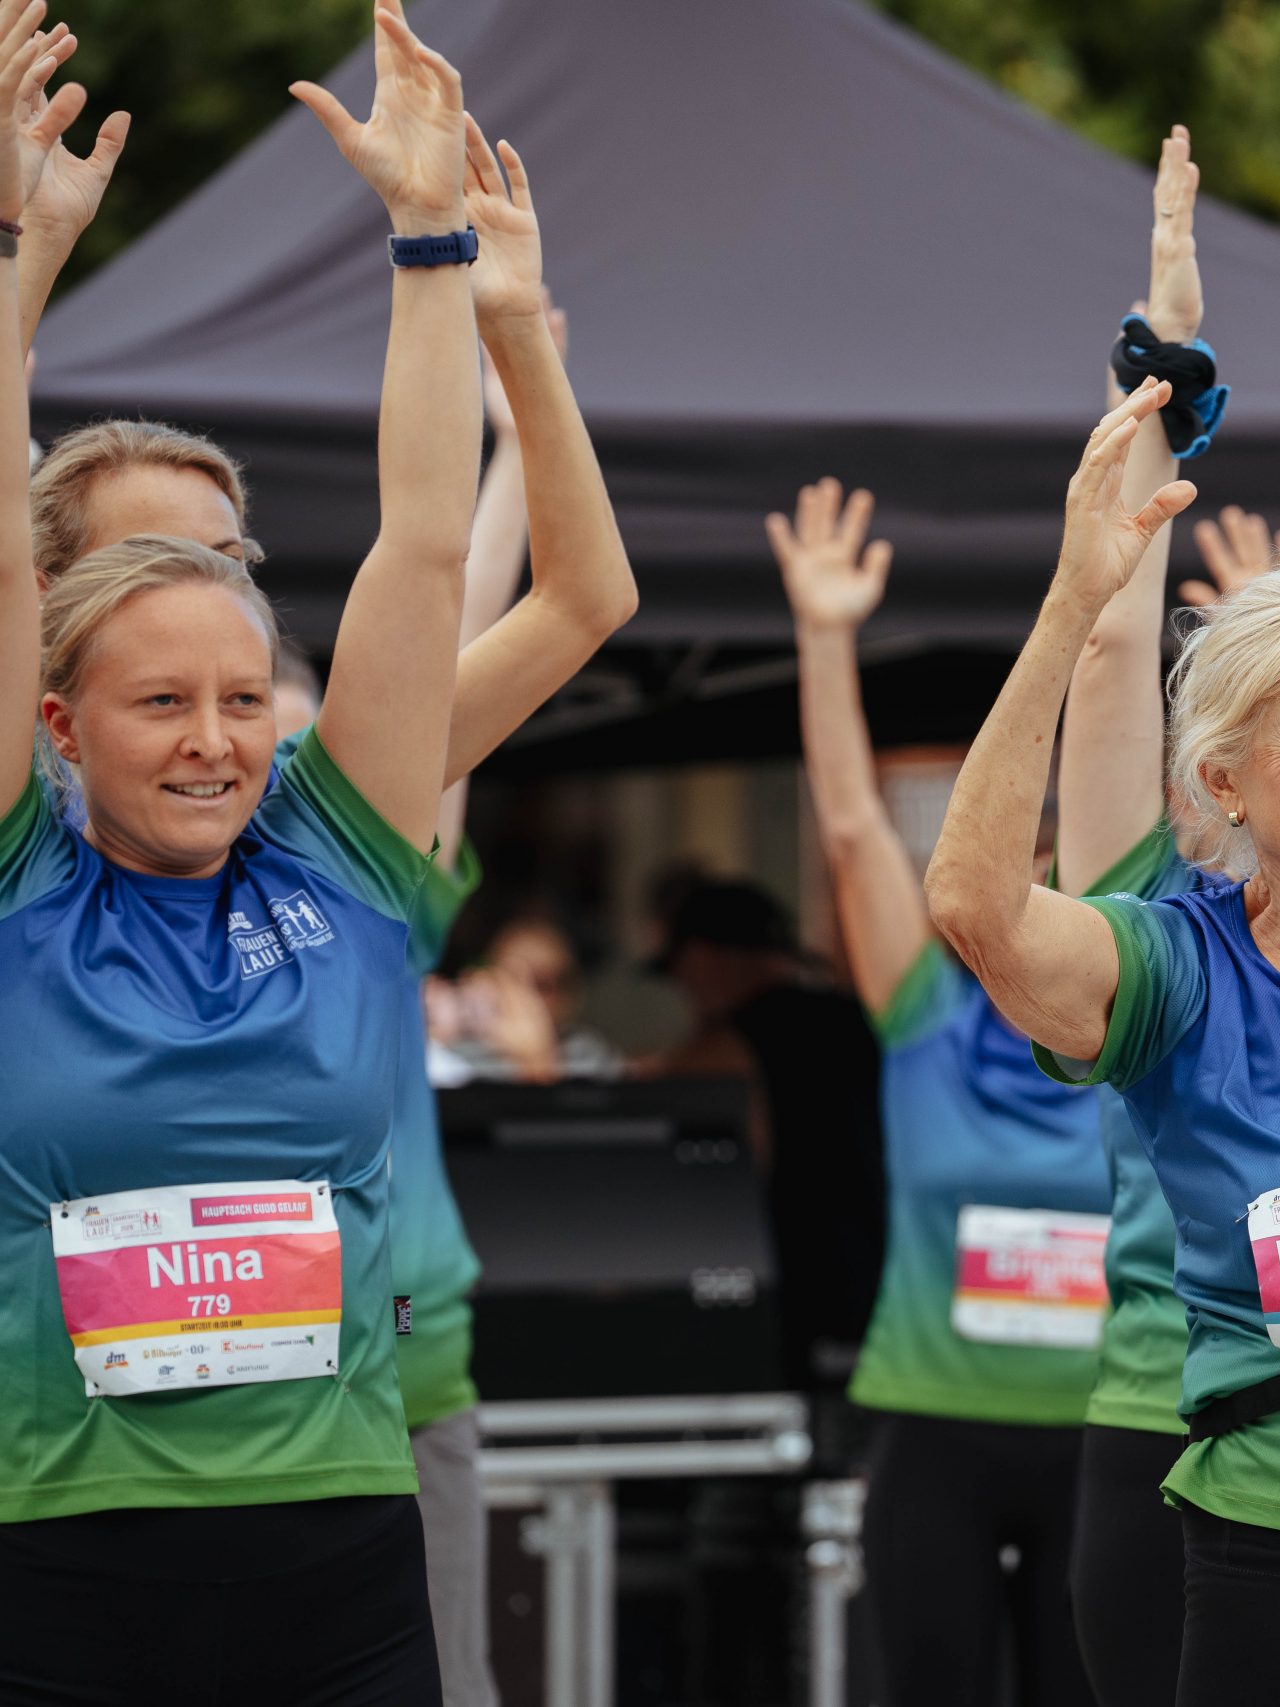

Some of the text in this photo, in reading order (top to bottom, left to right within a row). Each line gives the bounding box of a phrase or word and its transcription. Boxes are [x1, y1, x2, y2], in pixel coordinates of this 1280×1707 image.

[241, 943, 284, 974] LAUF
[201, 1201, 307, 1218] HAUPTSACH GUDD GELAAF
[146, 1243, 264, 1289] Nina
[187, 1293, 231, 1317] 779
[180, 1321, 212, 1332] STARTZEIT
[106, 1352, 126, 1364] dm
